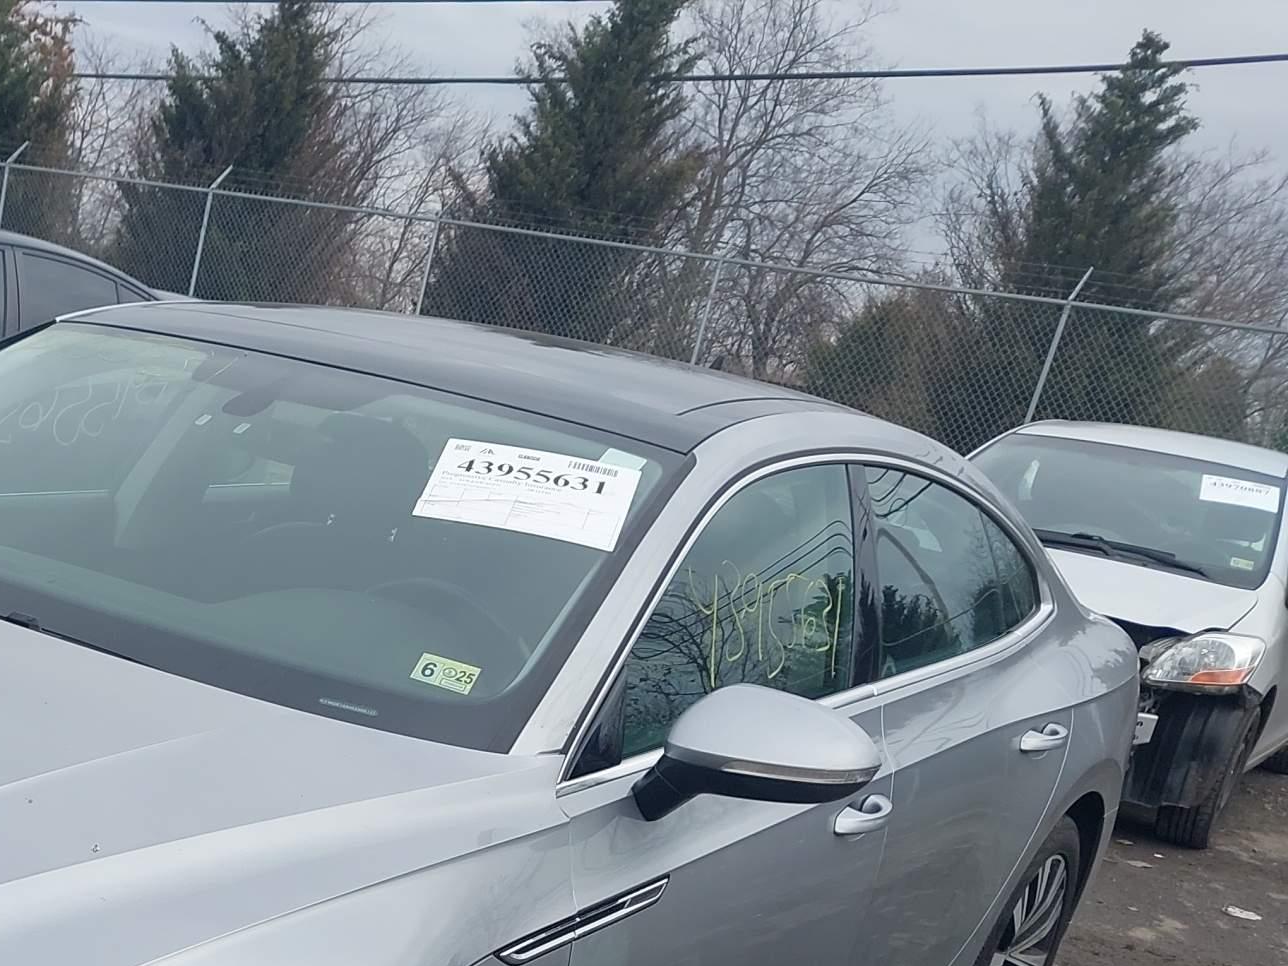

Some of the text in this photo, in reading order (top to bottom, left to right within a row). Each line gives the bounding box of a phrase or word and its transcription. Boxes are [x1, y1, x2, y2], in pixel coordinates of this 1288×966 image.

[457, 458, 607, 495] 43955631
[421, 662, 476, 685] 6 25
